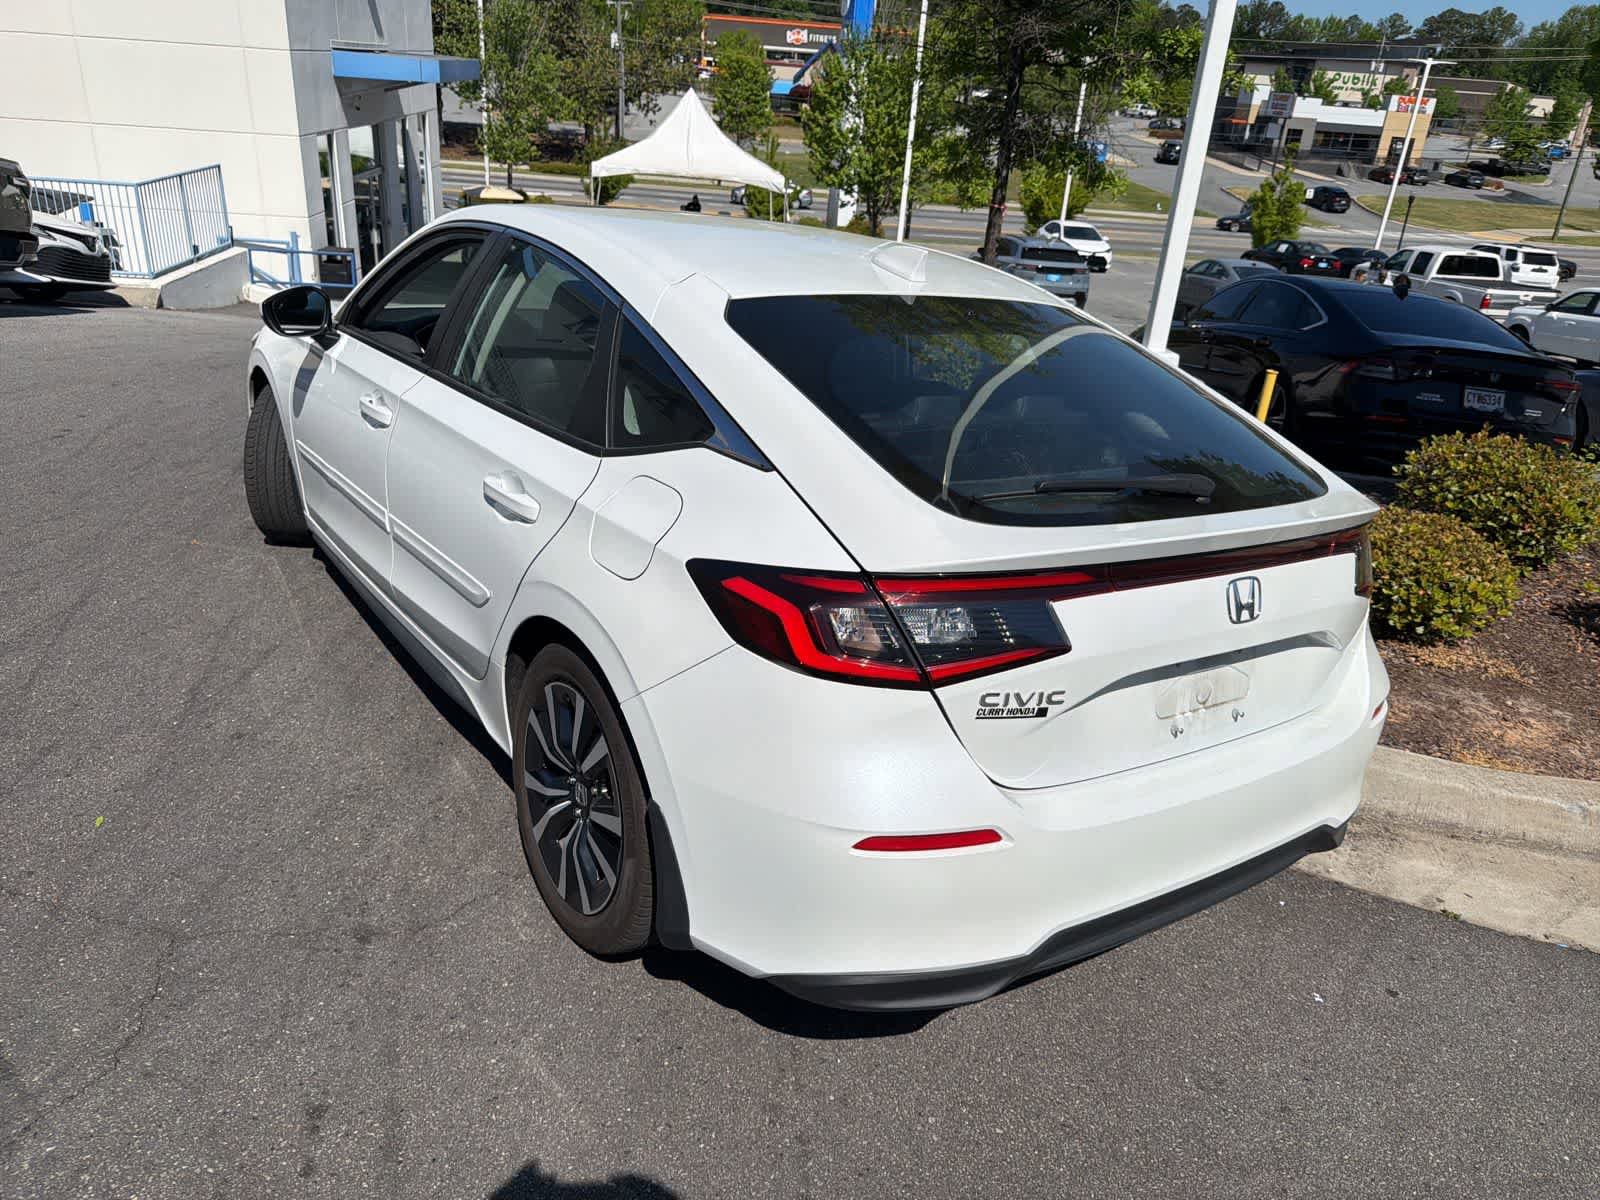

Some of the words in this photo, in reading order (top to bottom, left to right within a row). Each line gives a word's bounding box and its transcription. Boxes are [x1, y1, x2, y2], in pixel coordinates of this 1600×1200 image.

[979, 690, 1066, 708] CIVIC
[976, 707, 1005, 717] CURRY
[1006, 706, 1036, 716] HONDA
